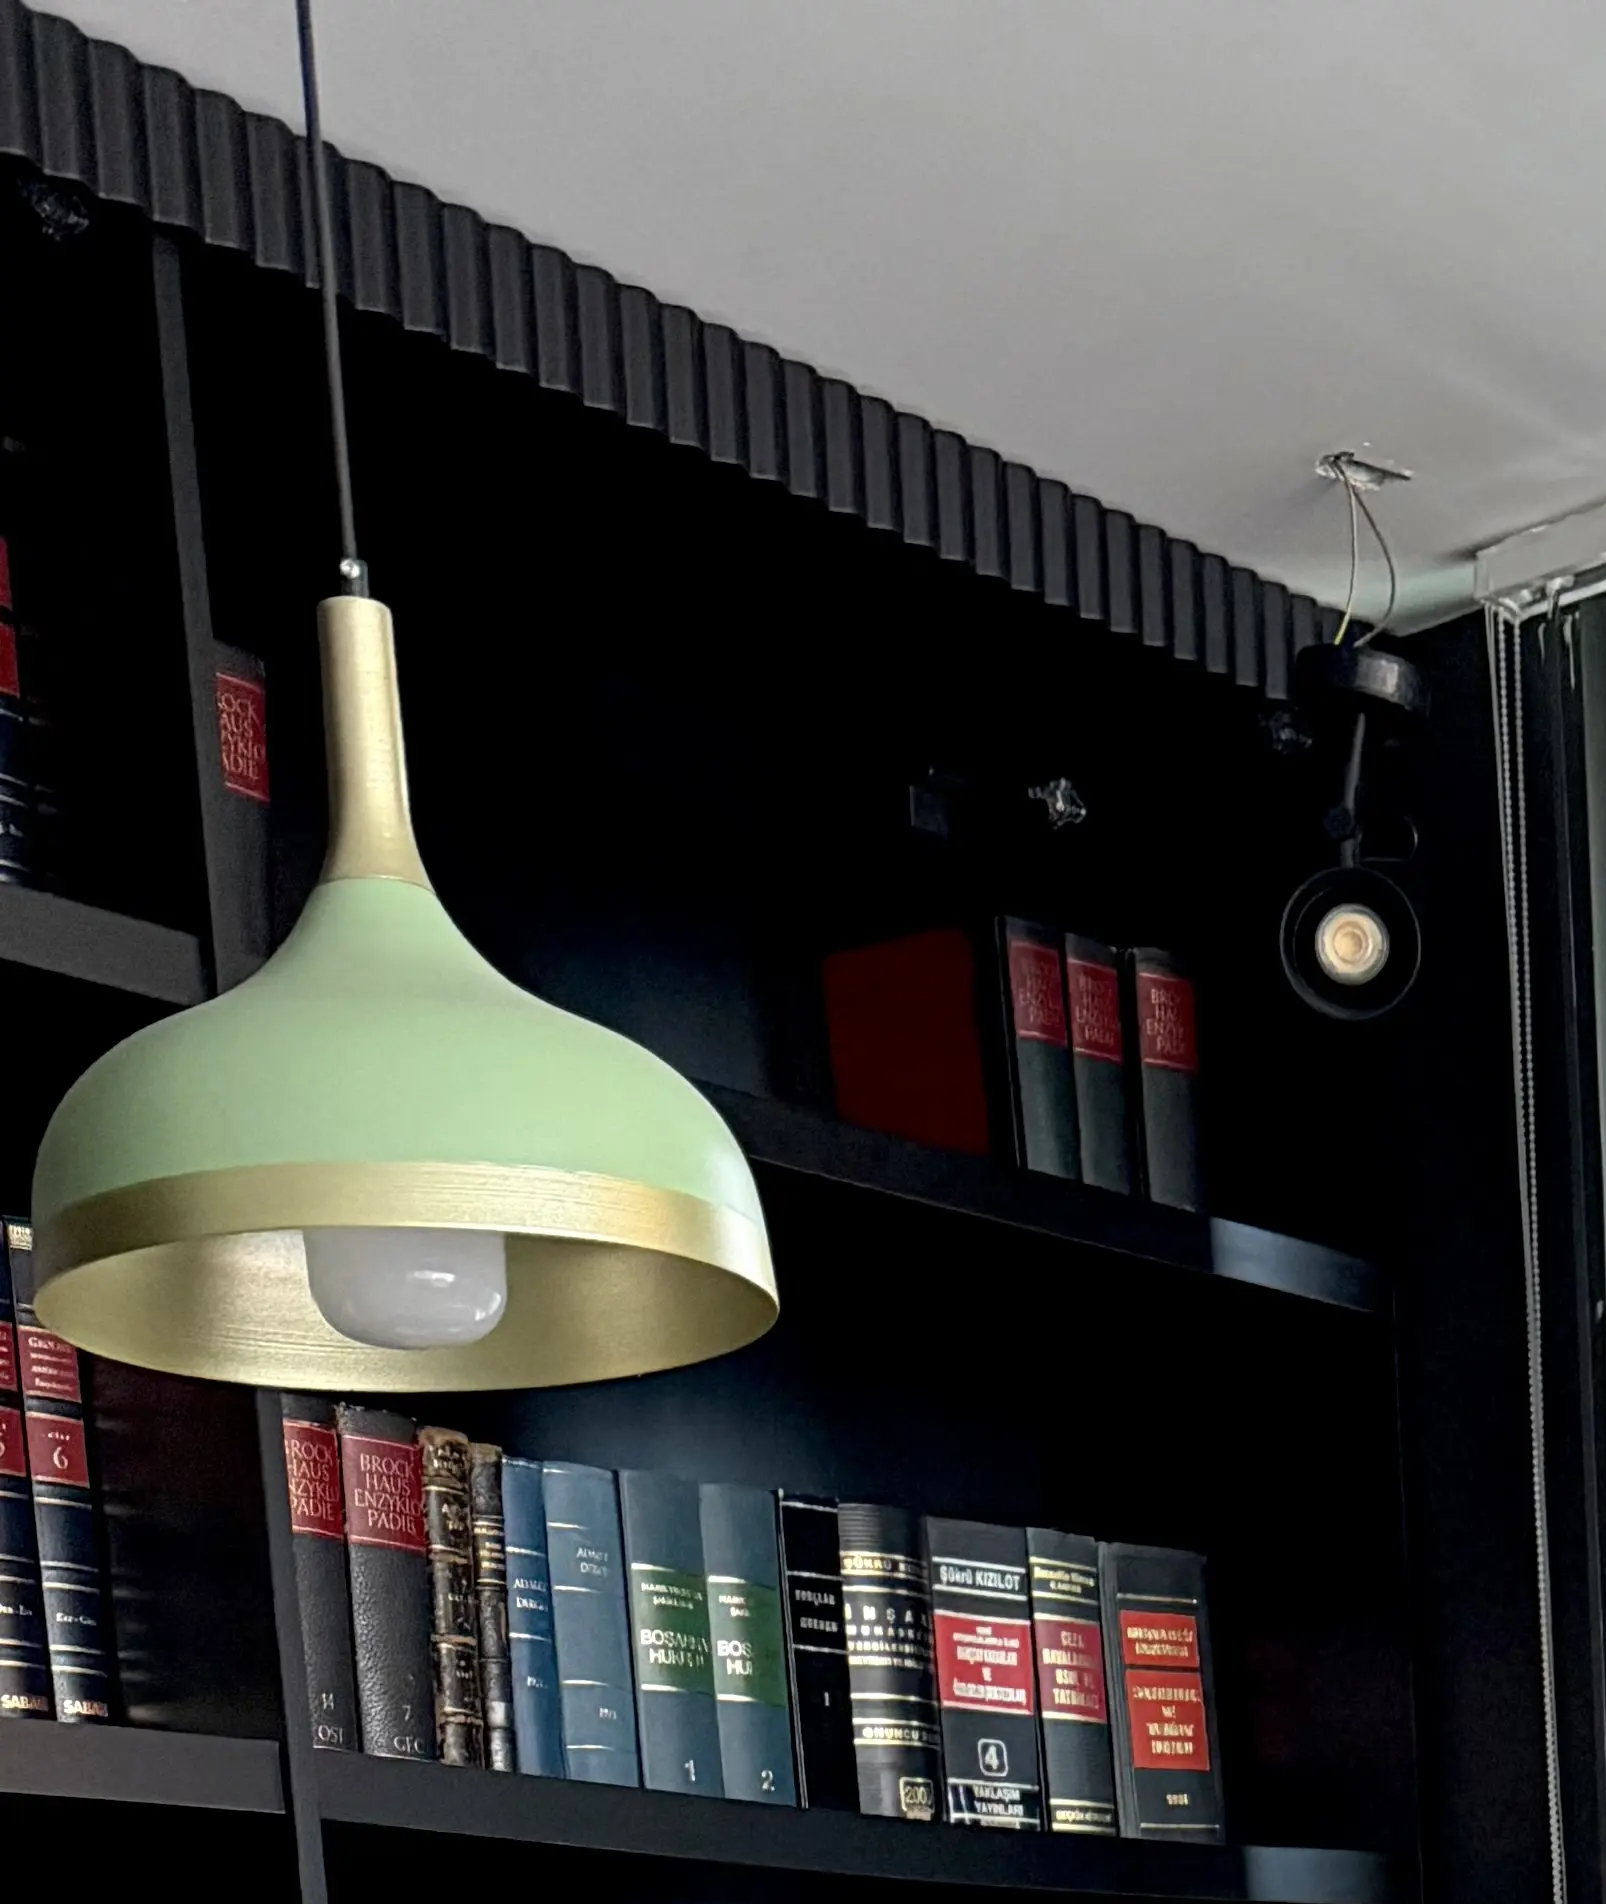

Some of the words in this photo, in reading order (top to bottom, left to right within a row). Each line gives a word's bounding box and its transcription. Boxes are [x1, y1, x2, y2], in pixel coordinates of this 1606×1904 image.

[52, 1445, 69, 1470] 6
[359, 1453, 415, 1482] BROCK
[365, 1471, 411, 1498] HAUS
[975, 1570, 1020, 1592] KIZILOT
[684, 1759, 696, 1782] 1
[985, 1744, 998, 1771] 4
